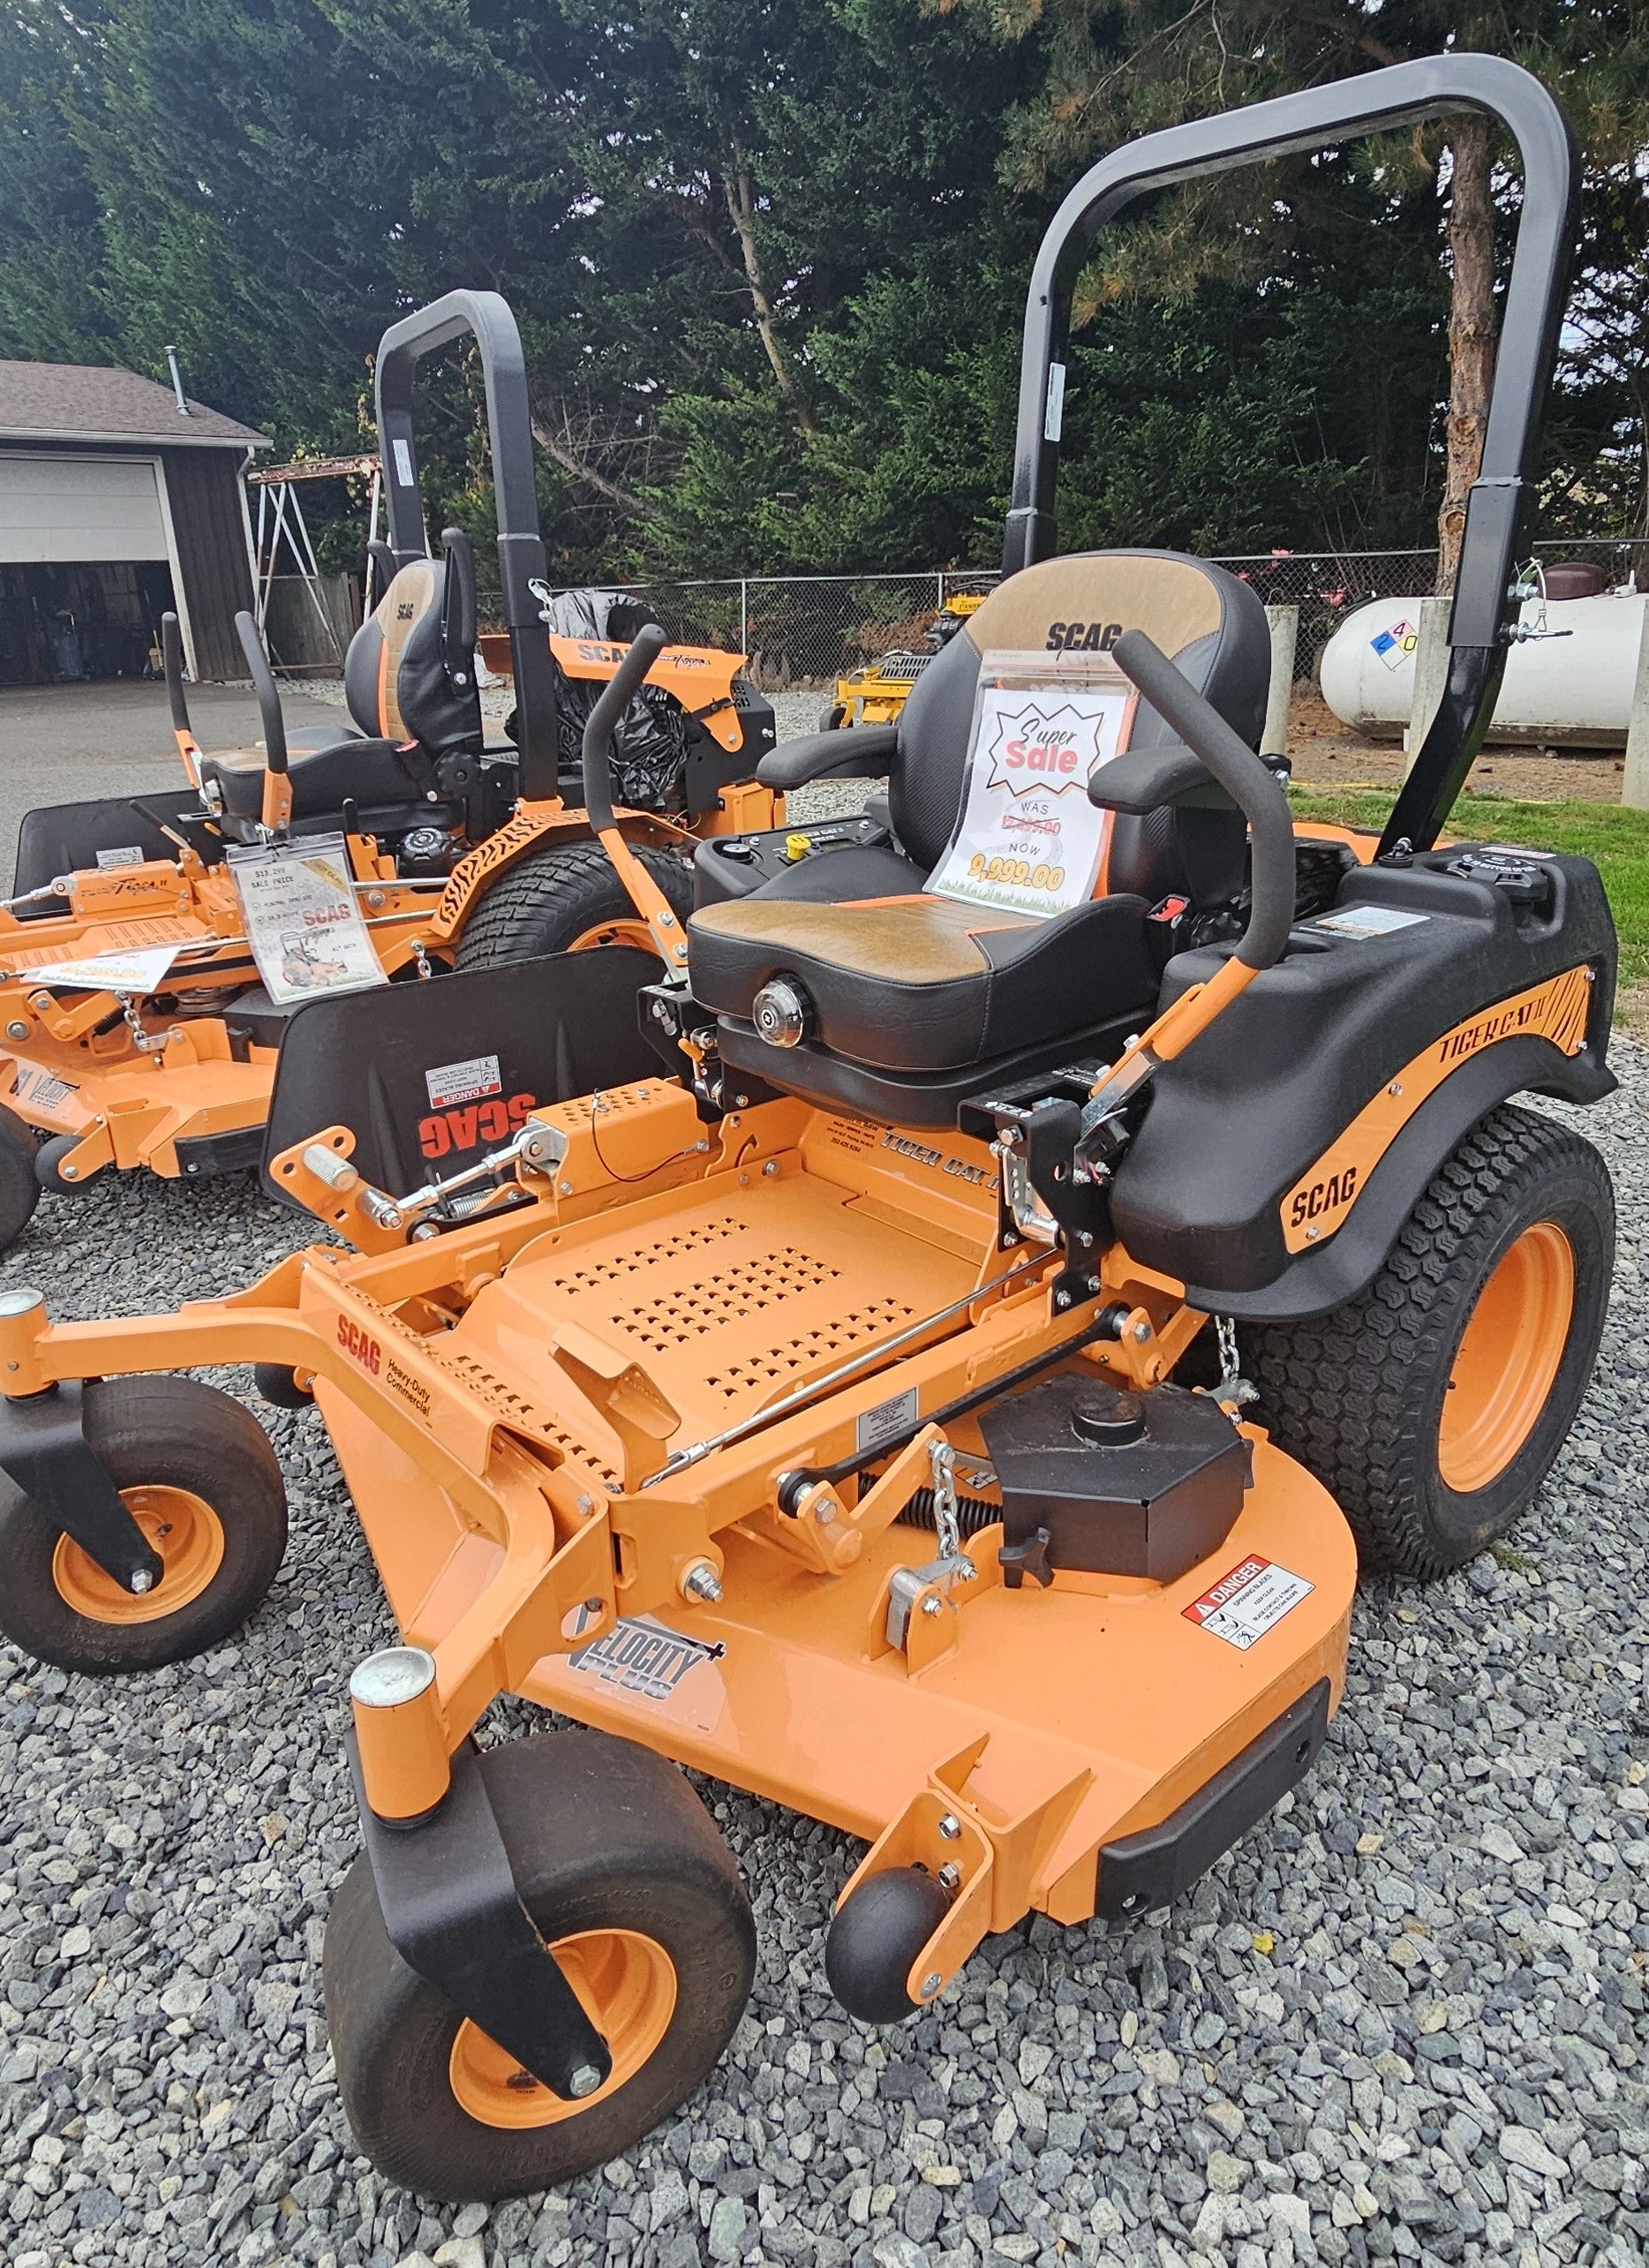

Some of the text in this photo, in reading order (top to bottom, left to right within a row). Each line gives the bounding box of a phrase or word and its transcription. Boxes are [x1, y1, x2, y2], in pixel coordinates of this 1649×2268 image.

[1045, 622, 1123, 652] SCAG
[1377, 632, 1418, 651] 2 0
[1392, 622, 1406, 637] 4
[578, 644, 629, 664] SCA
[1020, 718, 1078, 752] Super
[1005, 740, 1079, 775] Sale
[1020, 802, 1050, 815] WAS
[1008, 843, 1041, 855] NOW
[252, 879, 269, 889] SALE
[273, 875, 295, 885] PRICE
[967, 853, 1065, 892] 9,999.00
[302, 902, 352, 927] SCAG
[1438, 1017, 1501, 1063] TIGER
[1500, 1003, 1535, 1035] CAT
[441, 1087, 481, 1104] DANGER
[418, 1093, 536, 1159] SCAG
[880, 1130, 944, 1167] TIGER
[942, 1156, 992, 1187] CAT
[1291, 1166, 1358, 1228] SCAG
[337, 1313, 381, 1375] SCAG
[387, 1372, 431, 1417] Commercial
[388, 1358, 431, 1404] Heavy-Duty
[1209, 1561, 1264, 1604] DANGER
[578, 1654, 674, 1701] PLUS
